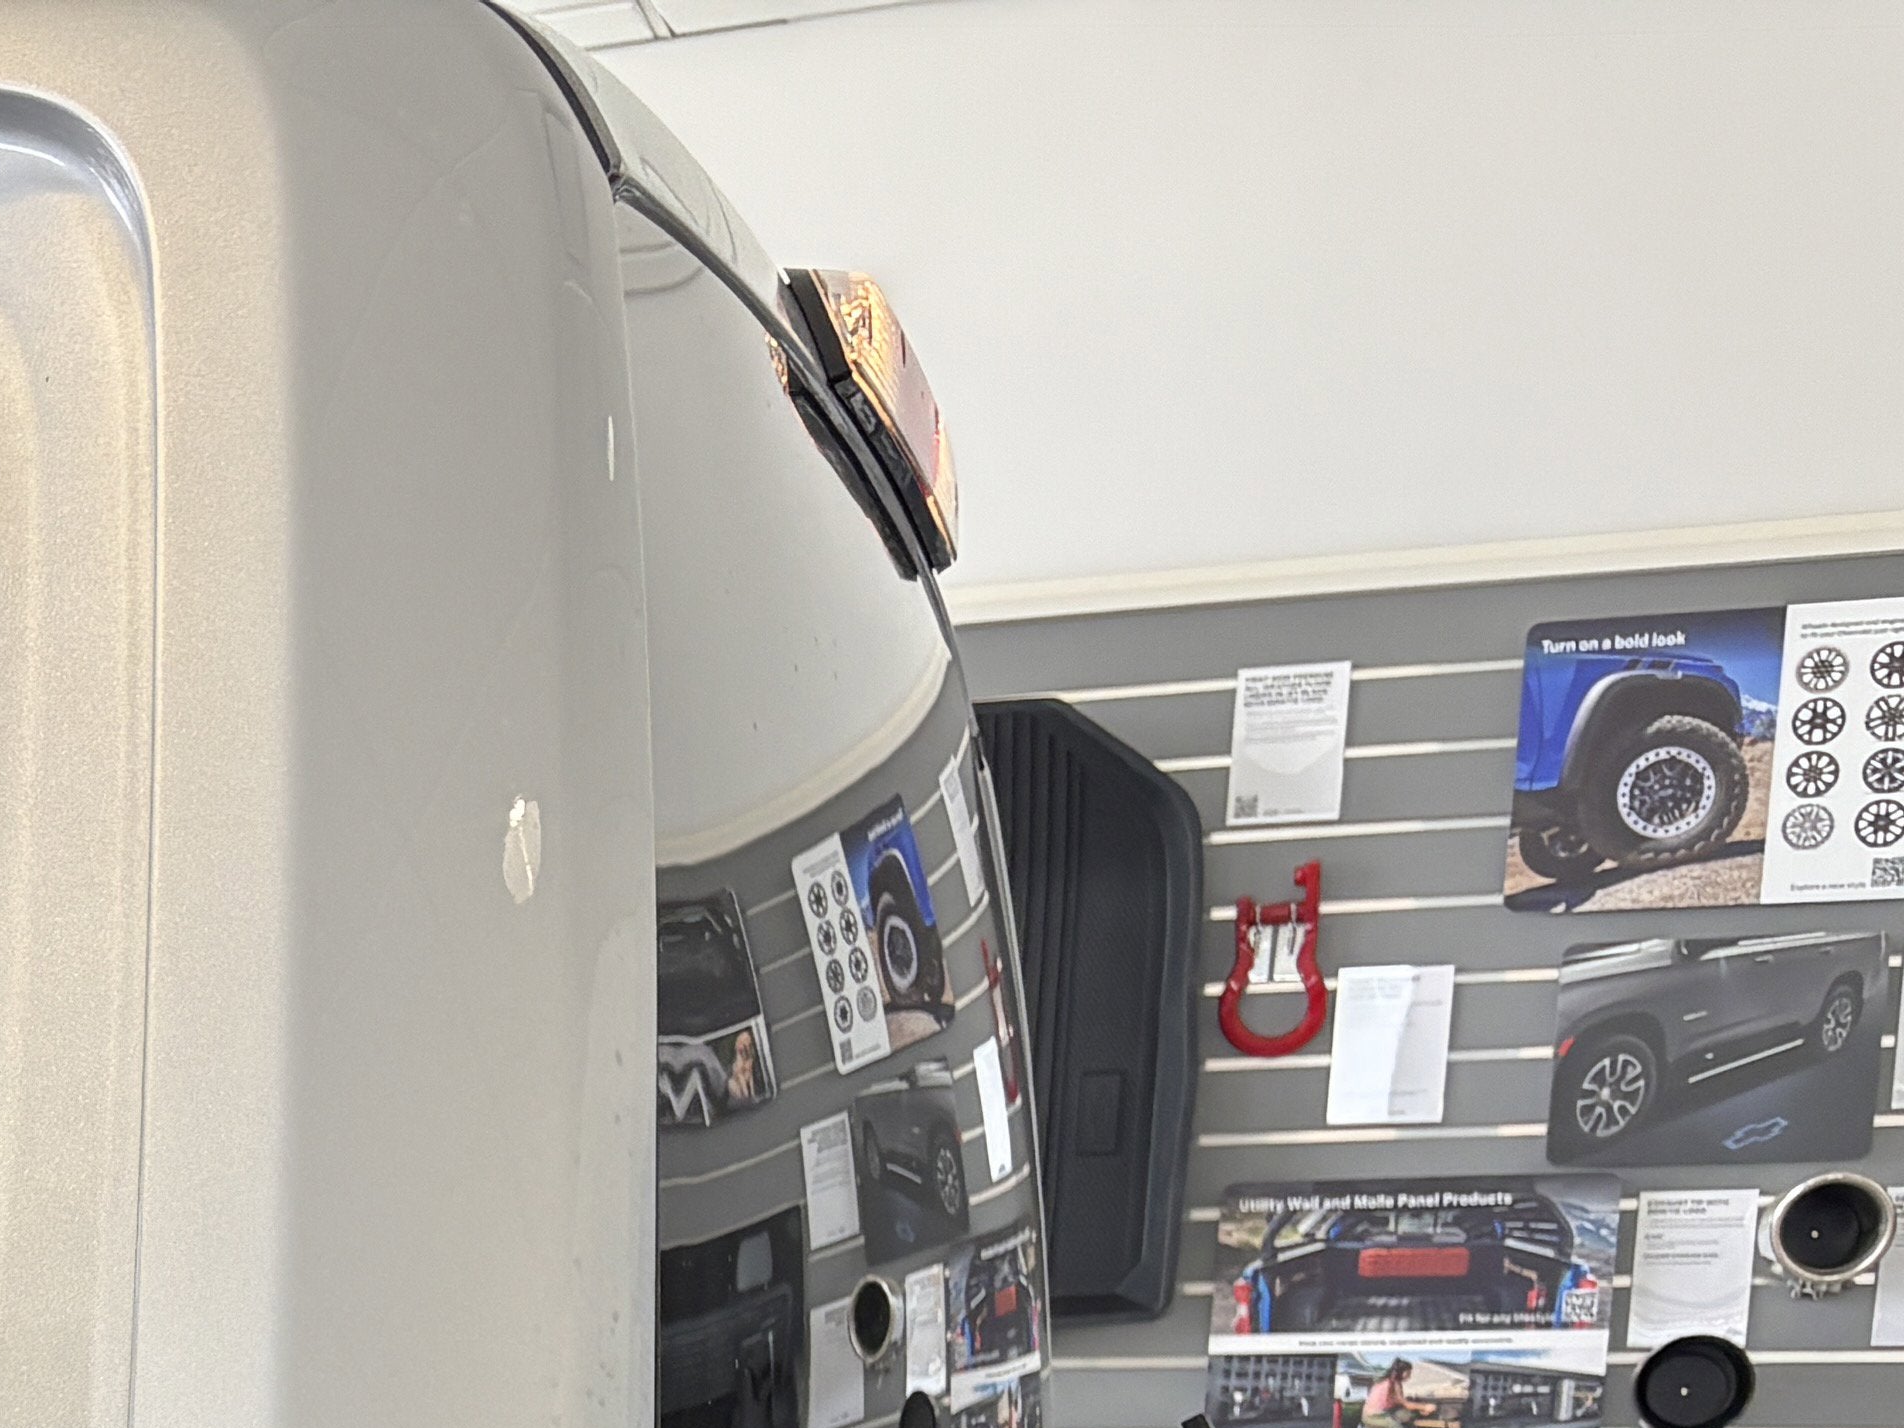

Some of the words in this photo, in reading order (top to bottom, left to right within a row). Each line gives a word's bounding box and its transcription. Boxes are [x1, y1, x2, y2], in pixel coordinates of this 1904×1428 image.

[1541, 638, 1577, 655] Turn
[1578, 639, 1599, 652] on
[1601, 638, 1613, 651] a
[1614, 631, 1649, 651] bold
[1651, 630, 1687, 648] look
[1238, 1195, 1284, 1215] Utility
[1286, 1195, 1320, 1212] Wall
[1321, 1193, 1351, 1211] and
[1396, 1191, 1440, 1210] Panel
[1442, 1190, 1514, 1209] Products
